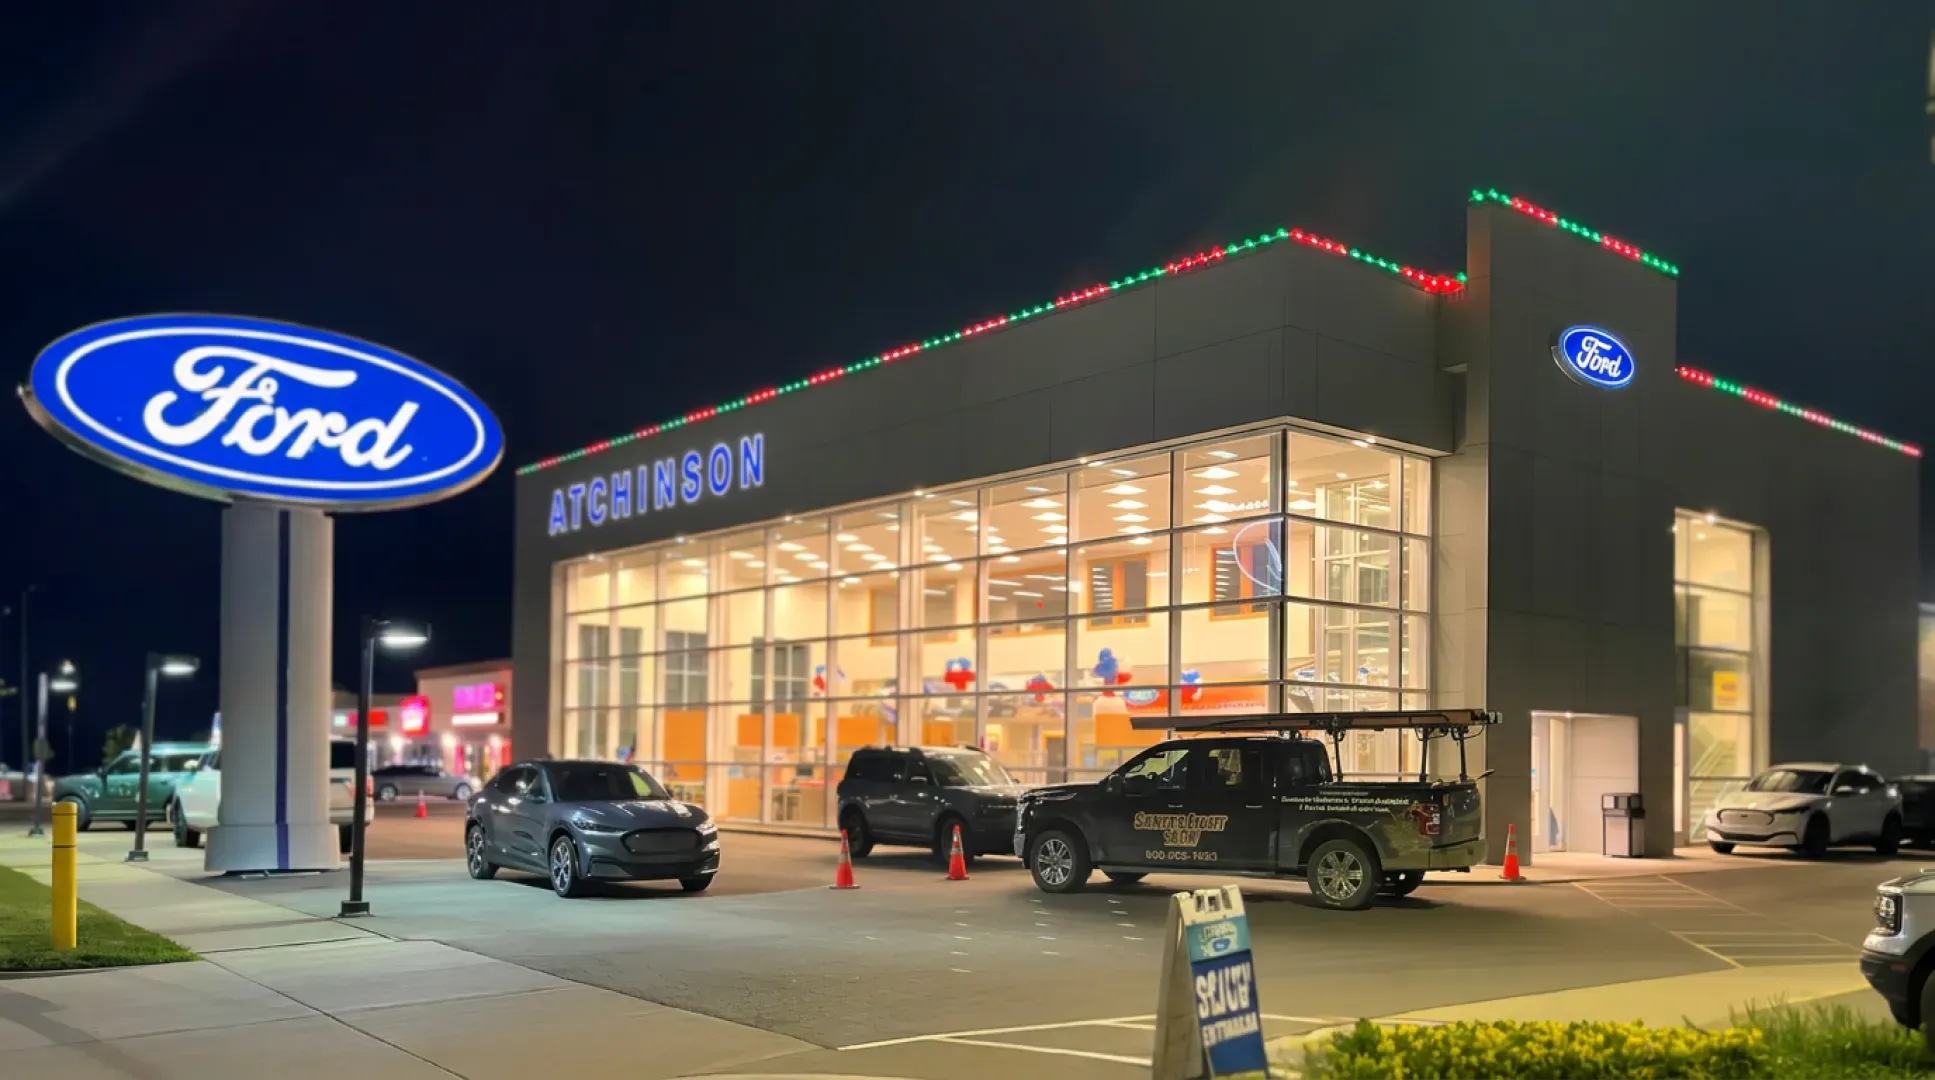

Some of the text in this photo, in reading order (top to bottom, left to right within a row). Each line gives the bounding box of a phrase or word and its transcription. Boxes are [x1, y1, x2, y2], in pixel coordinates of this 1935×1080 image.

[143, 345, 419, 470] Ford
[1576, 335, 1622, 378] Ford
[548, 432, 765, 536] ATCHINSON
